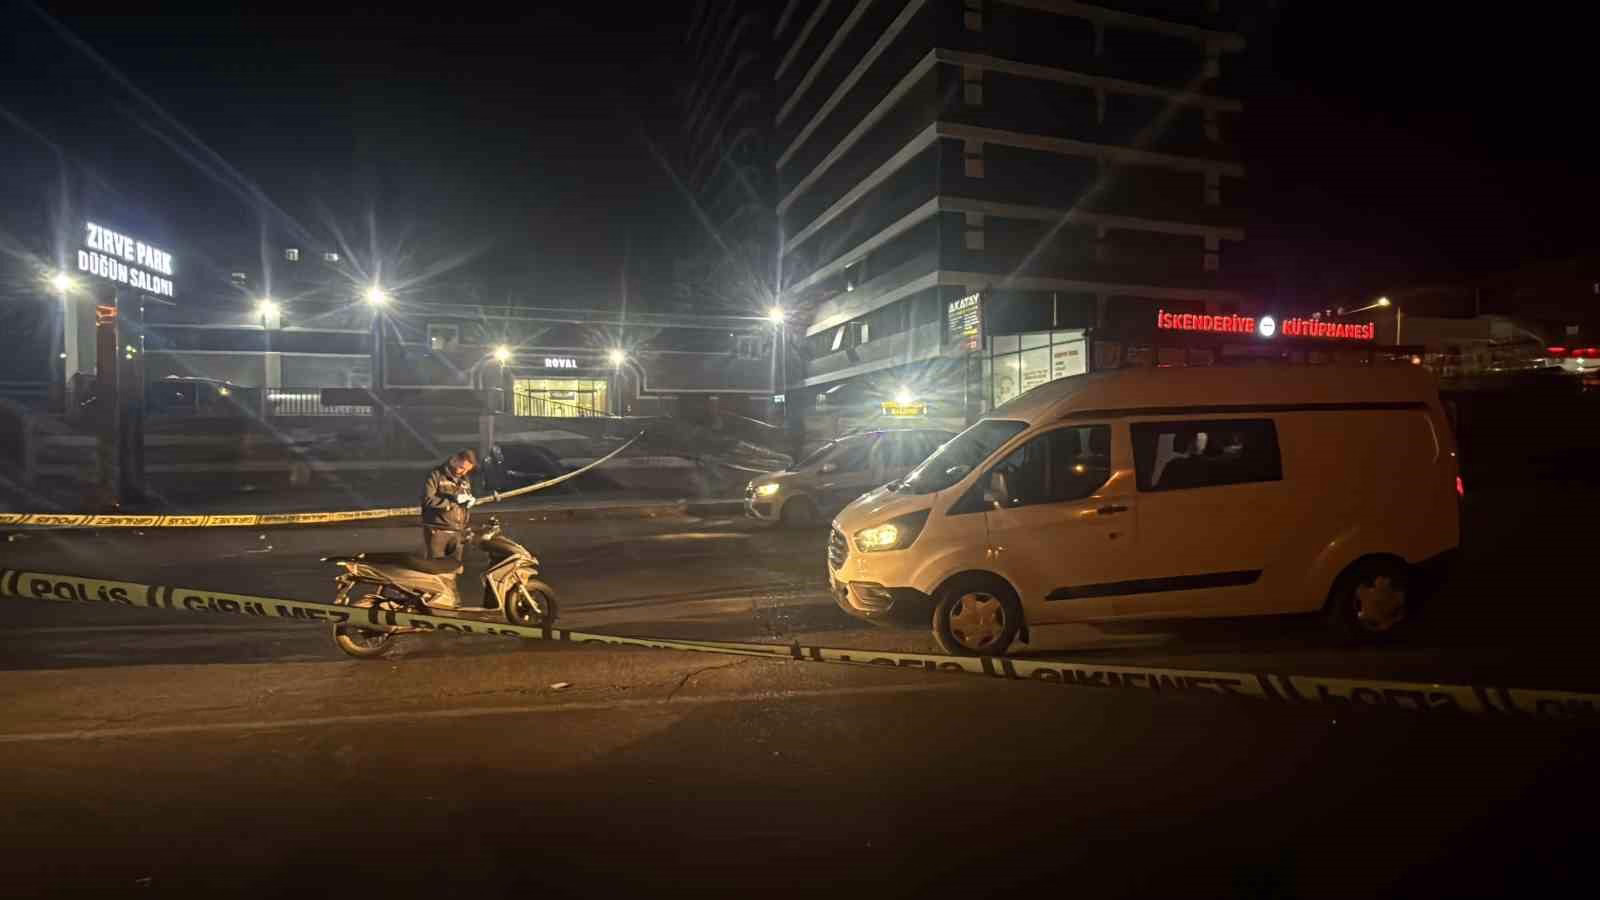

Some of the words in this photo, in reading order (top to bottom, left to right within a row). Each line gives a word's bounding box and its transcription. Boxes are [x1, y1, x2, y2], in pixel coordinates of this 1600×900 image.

[136, 240, 173, 276] PARK
[1157, 309, 1255, 334] İSKENDERİYE
[1281, 317, 1375, 340] KÜTÜPHANESİ
